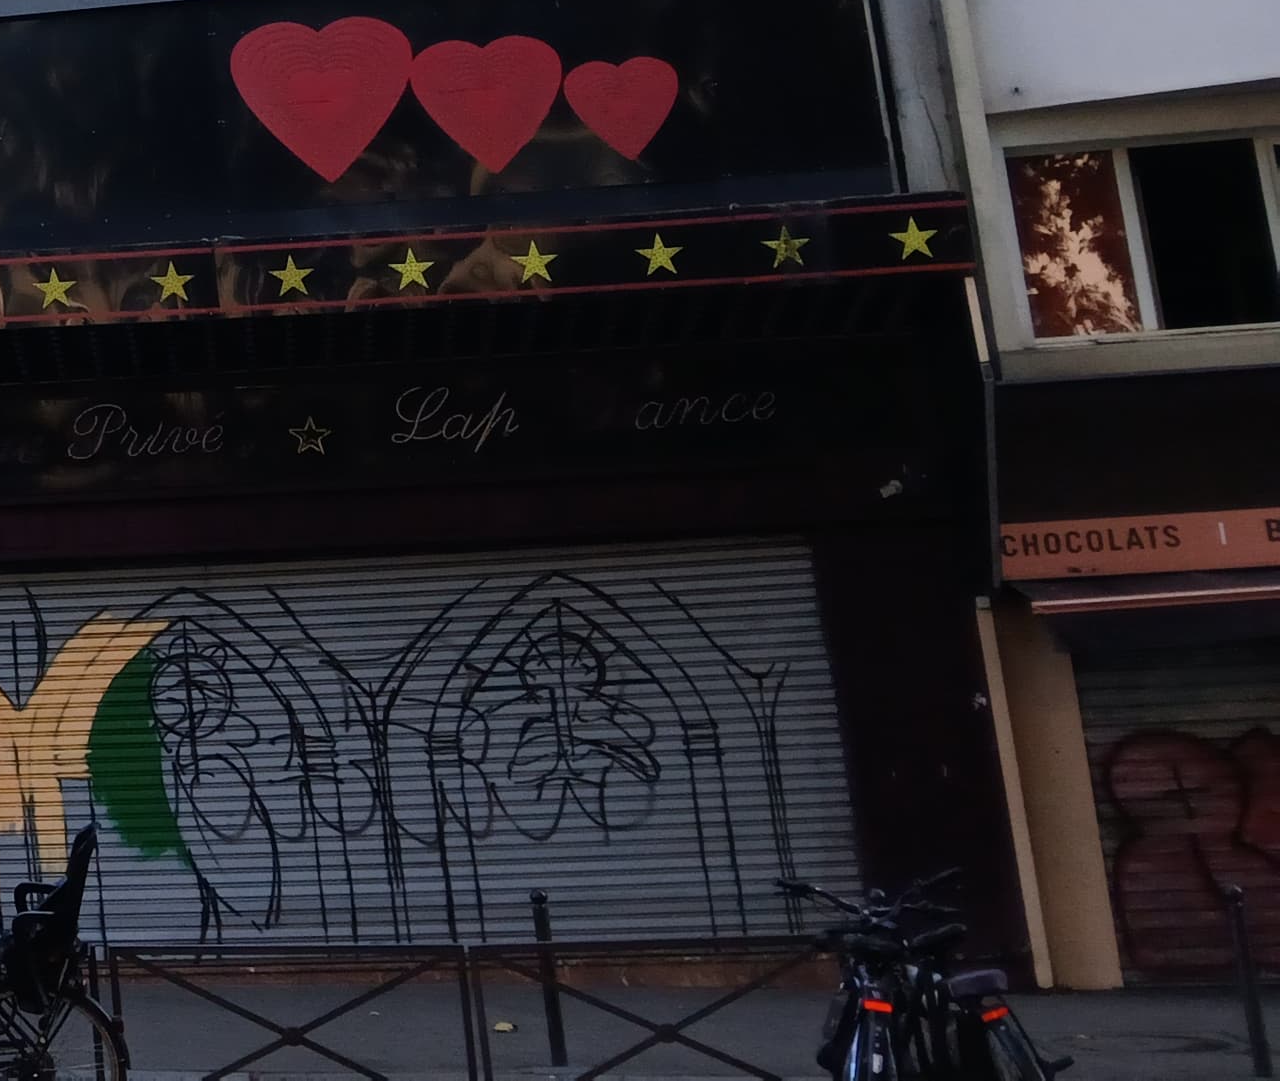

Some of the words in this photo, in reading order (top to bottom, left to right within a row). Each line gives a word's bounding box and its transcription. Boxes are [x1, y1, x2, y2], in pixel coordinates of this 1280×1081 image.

[66, 403, 226, 461] Privé
[390, 385, 520, 454] Lap
[1000, 524, 1182, 558] CHOCOLATS
